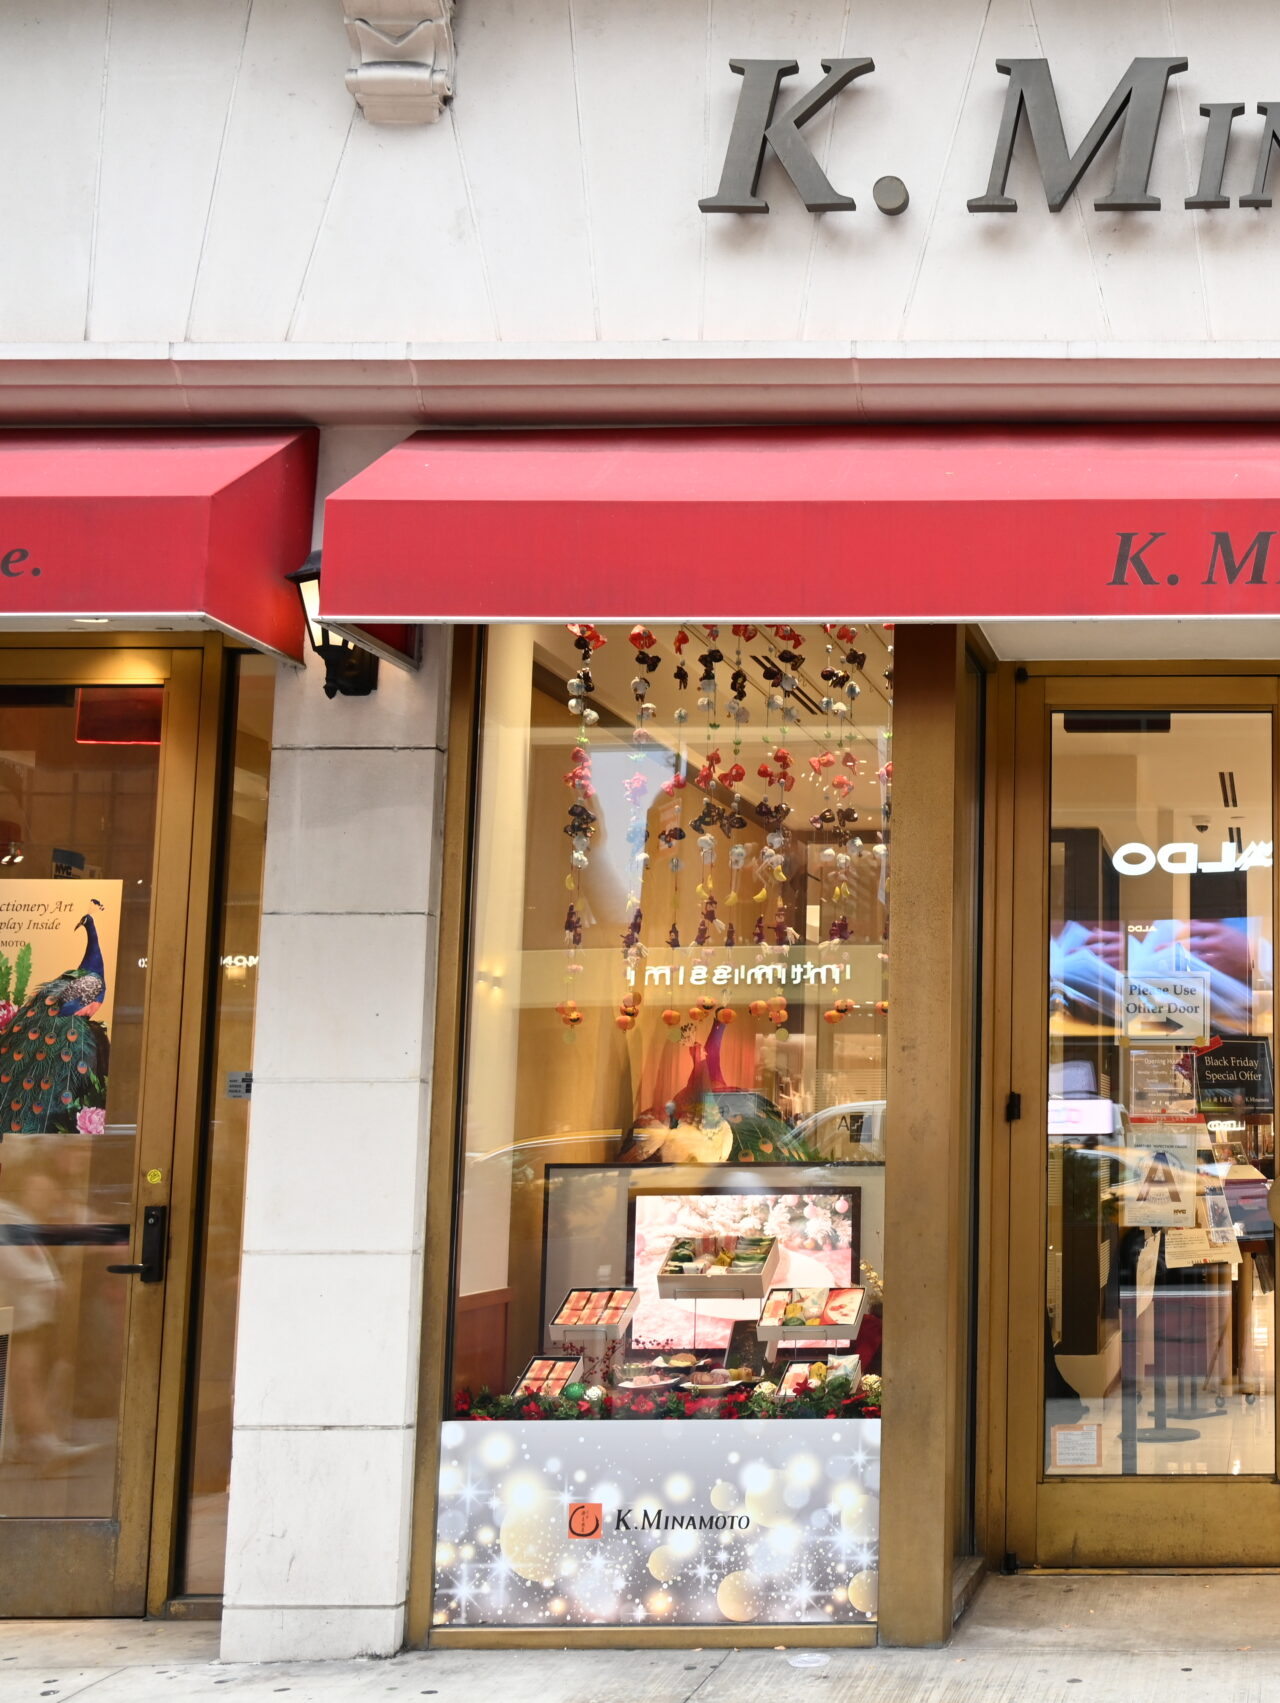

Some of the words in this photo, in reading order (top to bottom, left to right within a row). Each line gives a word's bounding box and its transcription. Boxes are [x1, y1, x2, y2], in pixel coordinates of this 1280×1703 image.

[698, 57, 909, 216] K.
[1107, 531, 1182, 588] K.
[50, 900, 74, 914] Art
[26, 918, 61, 930] Inside
[1128, 984, 1169, 996] Plese
[1173, 984, 1197, 996] Use
[1167, 1002, 1200, 1014] Door
[1204, 1056, 1229, 1067] Black
[1230, 1056, 1260, 1070] Friday
[1205, 1070, 1237, 1084] Special
[1238, 1070, 1262, 1081] Offer
[1136, 1152, 1182, 1202] A
